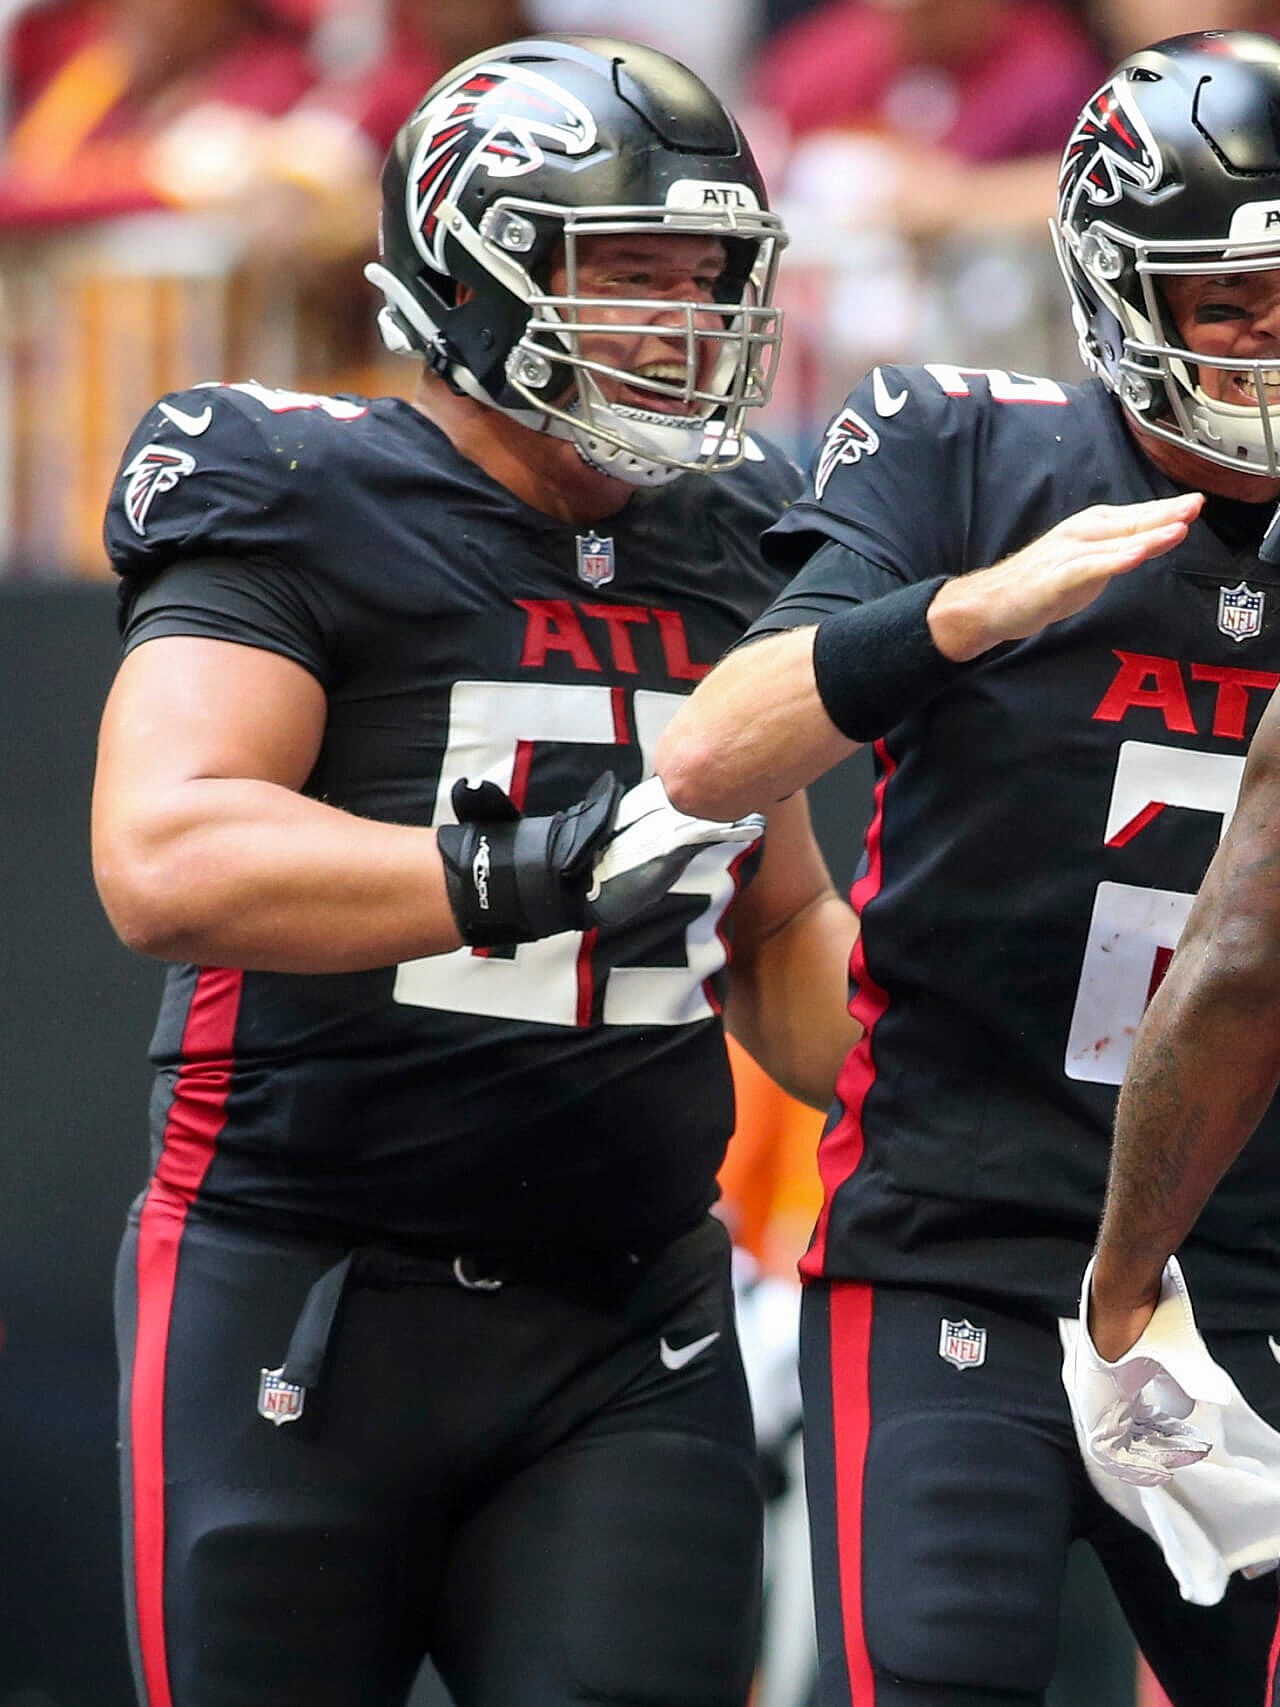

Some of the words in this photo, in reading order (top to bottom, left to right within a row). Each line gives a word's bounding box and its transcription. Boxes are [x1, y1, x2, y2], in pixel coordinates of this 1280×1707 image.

[703, 188, 746, 207] ATL
[1225, 608, 1256, 631] NFL
[513, 598, 712, 681] ATL
[947, 1338, 978, 1360] NFL
